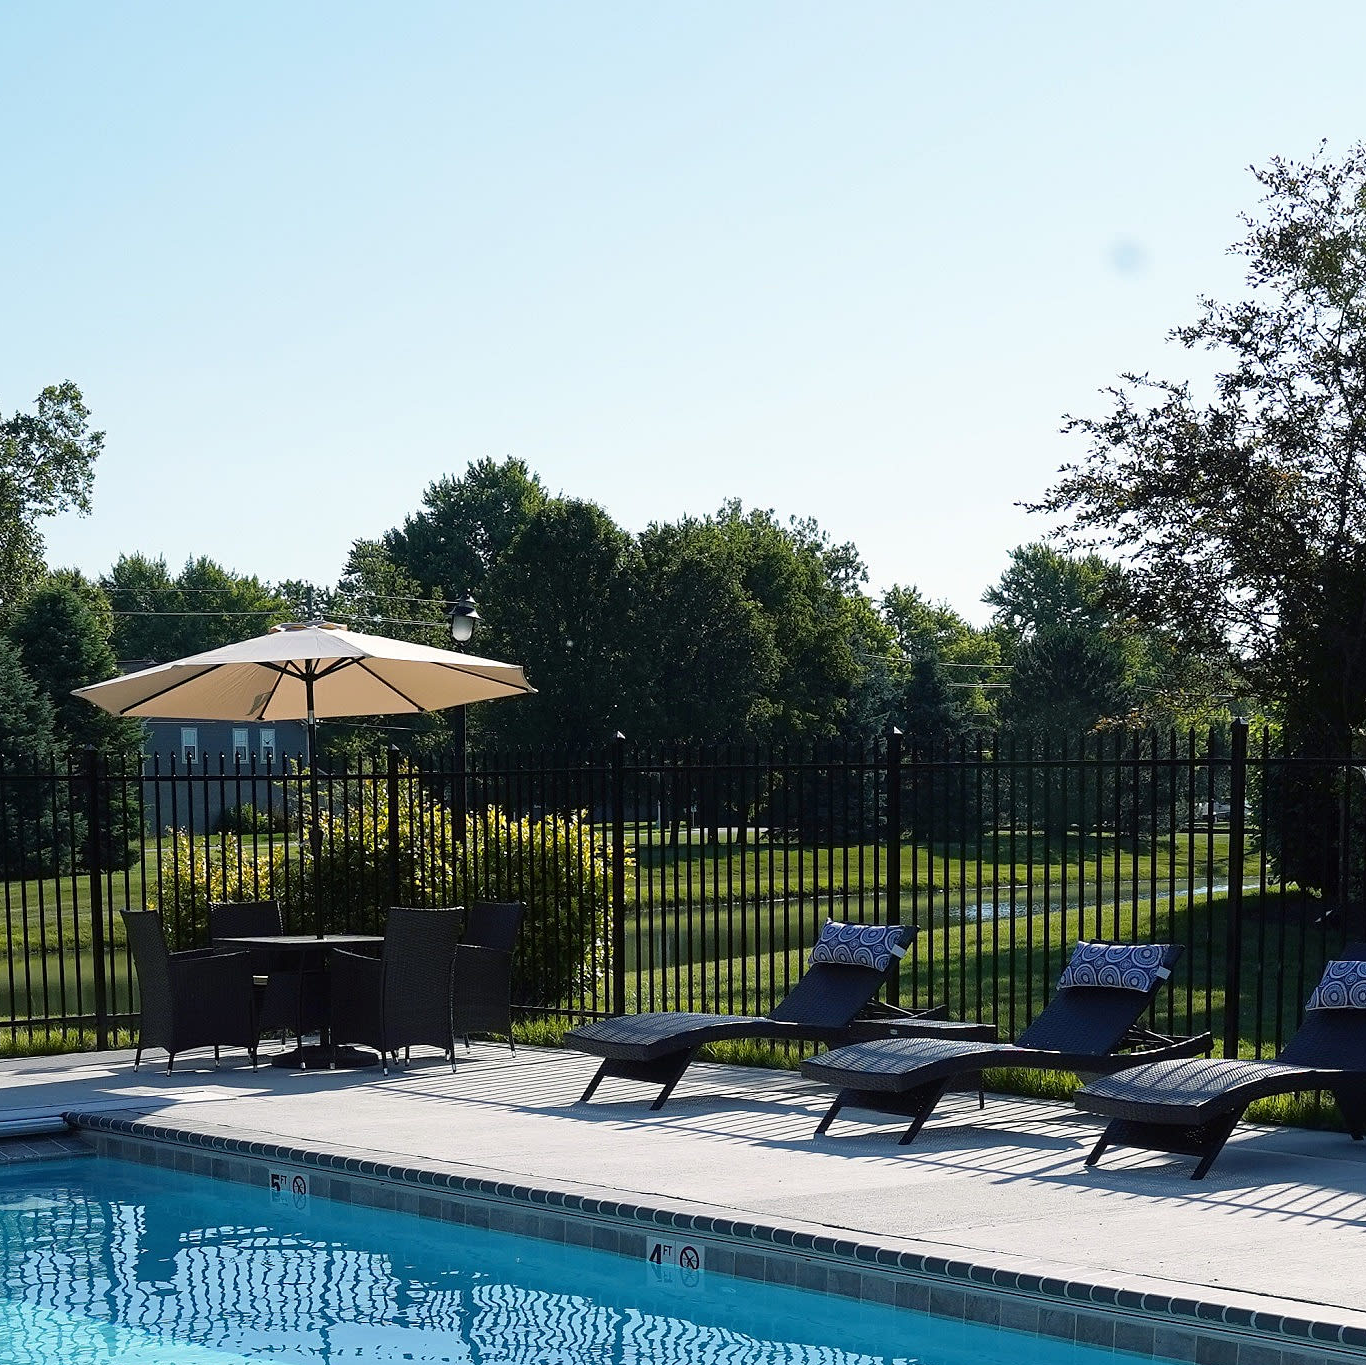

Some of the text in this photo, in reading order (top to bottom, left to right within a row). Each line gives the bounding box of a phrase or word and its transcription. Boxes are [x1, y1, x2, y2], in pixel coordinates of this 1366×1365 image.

[271, 1174, 281, 1191] 5
[649, 1243, 673, 1265] 4 FT
